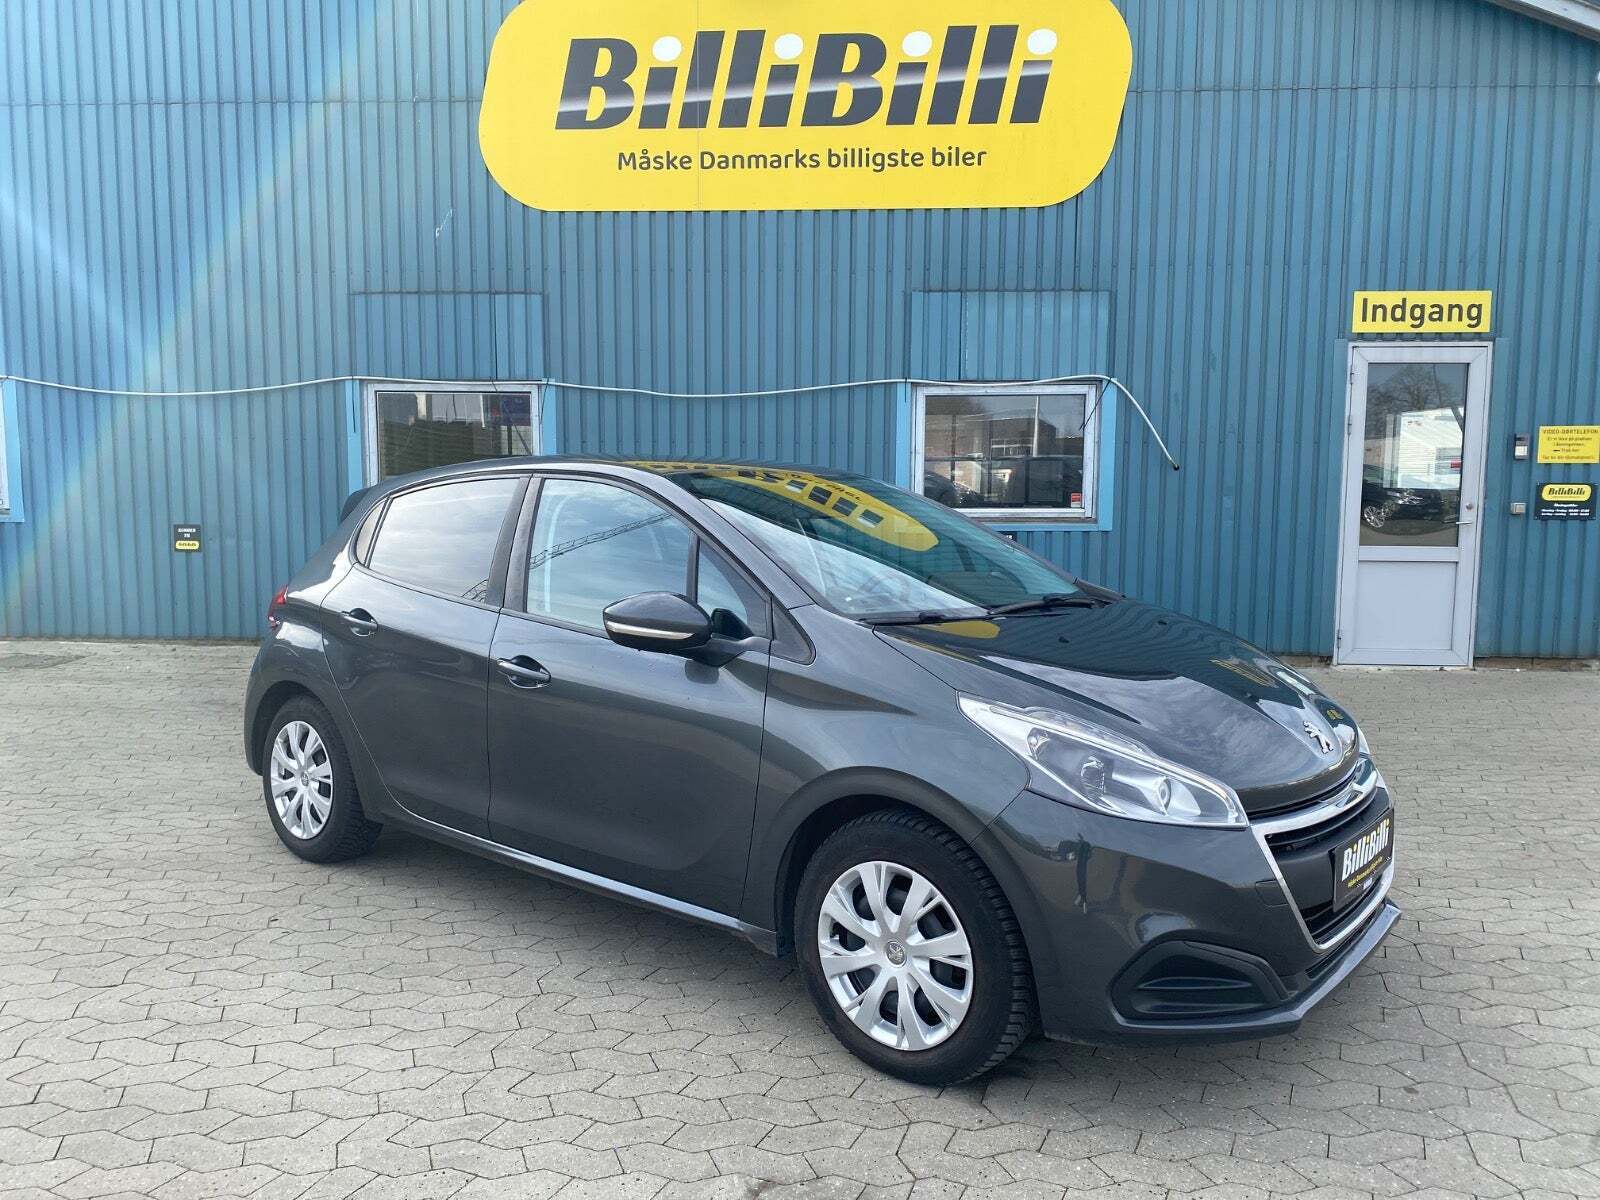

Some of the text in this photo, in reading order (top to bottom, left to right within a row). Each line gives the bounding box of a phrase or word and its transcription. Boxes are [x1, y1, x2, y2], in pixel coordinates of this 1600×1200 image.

[555, 24, 1057, 129] BilliBilli
[617, 146, 987, 173] Måske Danmarks billigste biler
[1361, 297, 1483, 328] Indgang
[1548, 487, 1586, 496] BilliBilli
[1342, 818, 1390, 881] BilliBilli
